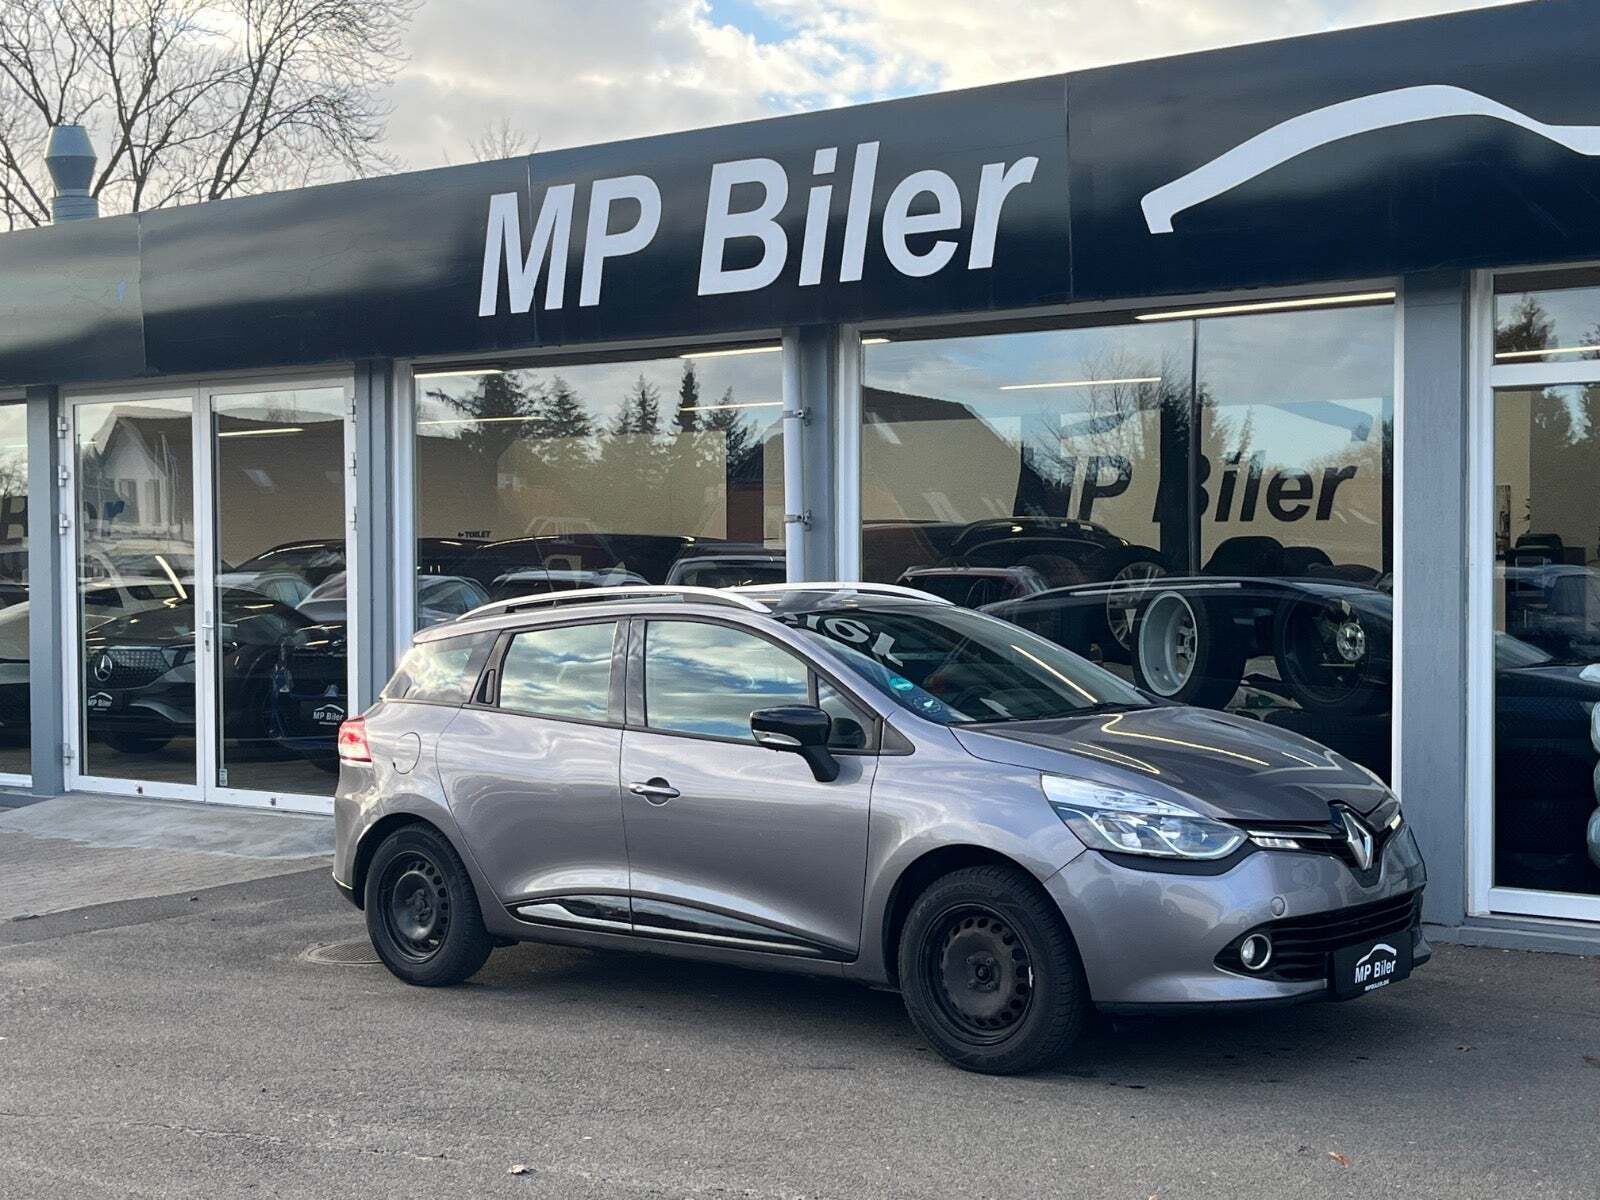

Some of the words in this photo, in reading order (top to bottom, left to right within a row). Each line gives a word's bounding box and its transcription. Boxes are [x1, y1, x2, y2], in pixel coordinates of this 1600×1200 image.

[478, 174, 662, 317] MP
[697, 140, 1039, 296] Biler
[313, 711, 325, 720] MP
[326, 712, 344, 721] Biler
[1354, 964, 1371, 984] MP
[1373, 960, 1396, 978] Biler
